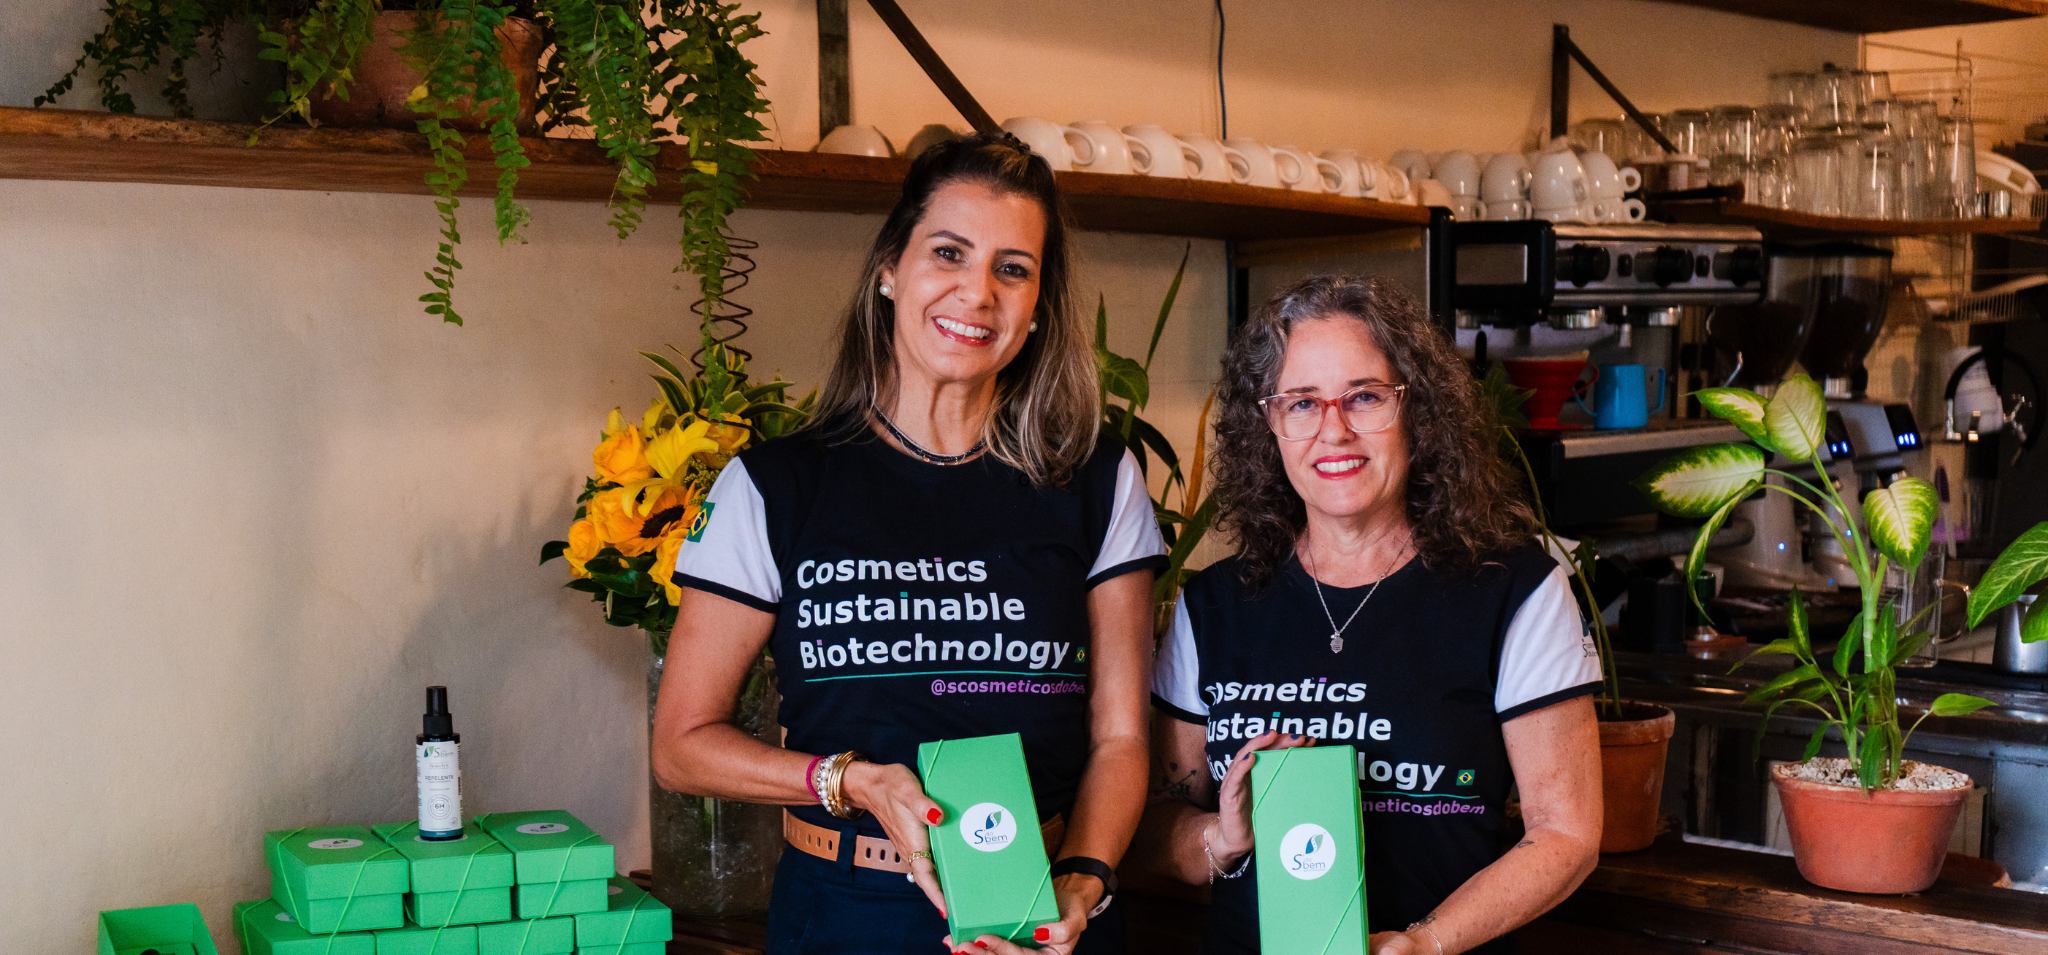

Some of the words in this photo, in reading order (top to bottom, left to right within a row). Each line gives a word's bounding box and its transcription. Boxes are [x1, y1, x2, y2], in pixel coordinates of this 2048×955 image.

[797, 557, 987, 589] Cosmetics
[797, 591, 1025, 628] Sustainable
[800, 633, 1070, 669] Biotechnology
[931, 679, 1086, 695] @scosmeticosdobe
[1206, 711, 1392, 743] ustainable
